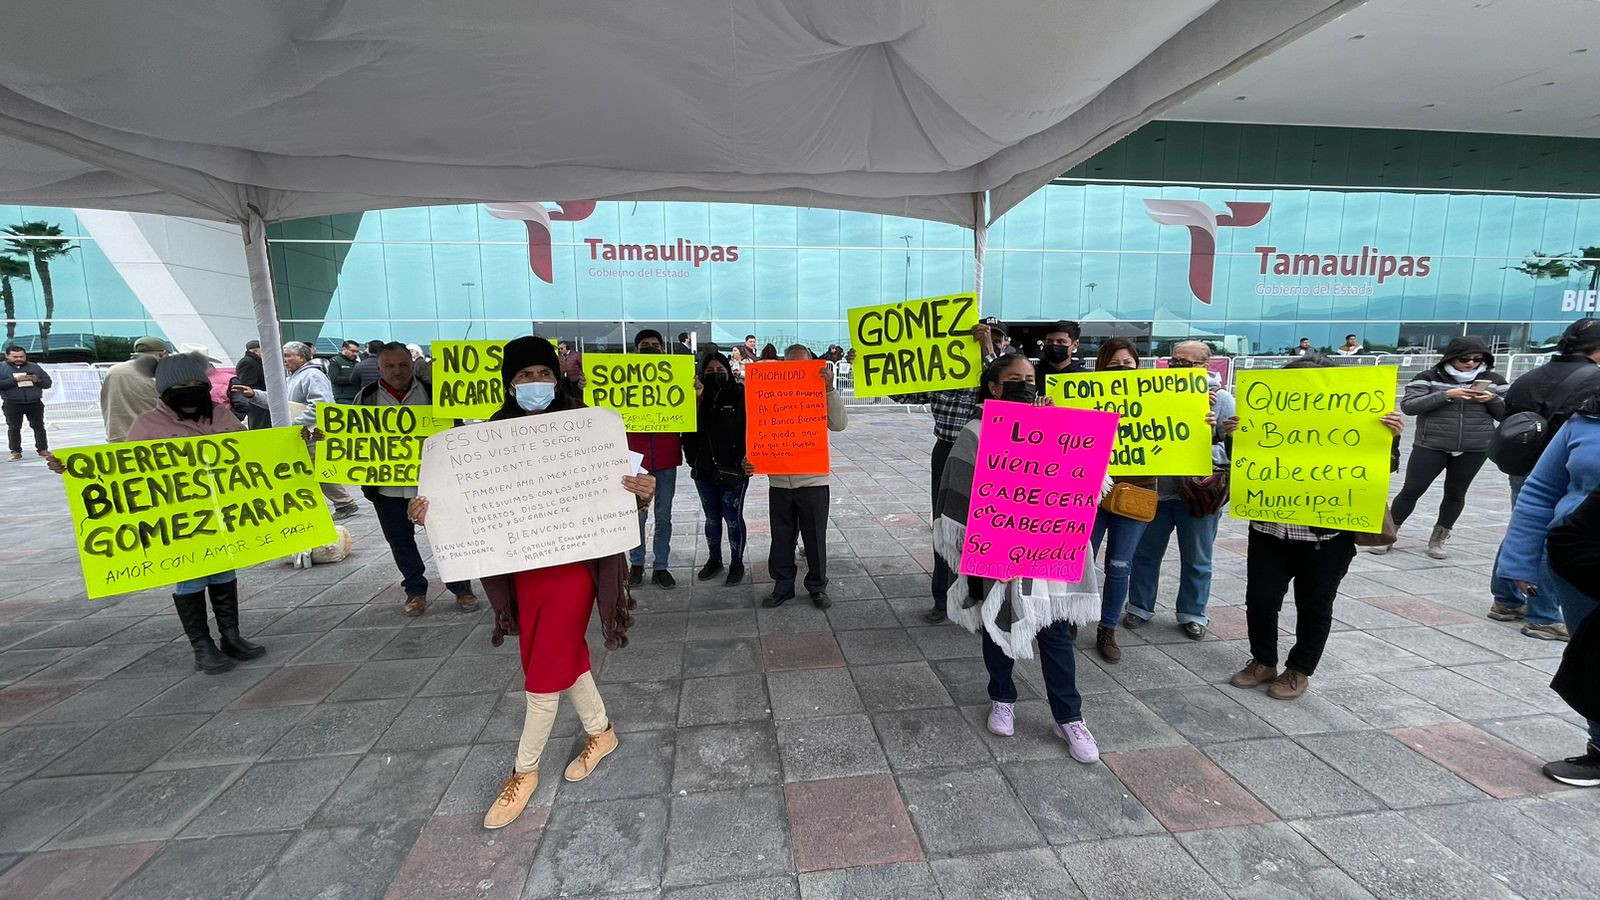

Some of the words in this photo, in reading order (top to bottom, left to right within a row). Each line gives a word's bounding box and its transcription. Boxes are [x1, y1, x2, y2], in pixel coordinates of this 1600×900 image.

[584, 238, 739, 267] Tamaulipas
[1254, 246, 1430, 283] Tamaulipas
[588, 268, 635, 278] Gobierno
[638, 268, 653, 278] del
[656, 269, 690, 278] Estado
[1255, 283, 1310, 297] Gobierno
[1312, 283, 1331, 297] del
[1333, 284, 1373, 297] Estado
[857, 297, 973, 346] GÓMEZ
[442, 344, 480, 374] NO
[484, 344, 503, 372] S
[592, 360, 673, 386] SOMOS
[863, 340, 971, 386] FARIAS
[439, 377, 503, 407] ACARR
[592, 384, 685, 408] PUEBLO
[1111, 377, 1128, 396] el
[1137, 372, 1208, 397] pueblo
[1246, 381, 1386, 415] Queremos
[324, 406, 417, 434] BANCO
[421, 415, 443, 428] DE
[771, 417, 794, 426] Banco
[1093, 398, 1143, 418] todo
[445, 433, 470, 450] ES
[477, 428, 503, 442] UN
[510, 421, 558, 437] HONOR
[563, 418, 593, 432] QUE
[625, 423, 670, 431] RESENTE
[771, 430, 796, 440] queda
[1117, 416, 1190, 446] pueblo
[1240, 418, 1255, 433] el
[1258, 421, 1361, 448] Banco
[326, 435, 429, 461] BIENEST
[450, 451, 482, 468] NOS
[488, 442, 537, 458] VISITE
[542, 434, 581, 447] SEÑOR
[1057, 432, 1096, 454] que
[66, 438, 242, 480] QUEREMOS
[321, 464, 338, 480] EN
[347, 463, 421, 484] CABEC
[456, 459, 533, 485] PRESIDENTE
[560, 442, 615, 460] SERVIDORA
[988, 451, 1060, 477] viene
[1071, 466, 1085, 478] a
[1235, 456, 1248, 468] en
[1246, 456, 1368, 482] Cabecera
[81, 461, 273, 520] BIENESTAR
[273, 460, 313, 480] en
[461, 483, 513, 500] TAMBIEN
[516, 478, 535, 488] AMA
[547, 466, 587, 480] MEXICO
[465, 505, 478, 514] LE
[481, 494, 534, 511] RESIVIMOS
[538, 489, 552, 498] CON
[556, 485, 572, 494] LOS
[575, 475, 609, 488] BRAZOS
[979, 483, 1095, 508] CABECERA
[471, 510, 515, 525] ABIERTOS
[521, 503, 544, 514] DIOS
[560, 490, 599, 504] BENDIGA
[1246, 488, 1352, 512] Municipal
[84, 508, 217, 557] GOMEZ
[221, 488, 318, 533] FARIAS
[472, 522, 503, 535] USTED
[528, 506, 570, 521] GABINETE
[507, 521, 575, 545] BIENVENIDO
[582, 516, 594, 525] EN
[597, 512, 617, 521] HORA
[973, 504, 997, 519] en
[991, 513, 1086, 534] CABECERA
[105, 559, 153, 584] AMOR
[160, 552, 194, 570] CON
[203, 539, 249, 560] AMOR
[257, 534, 273, 548] SE
[280, 524, 315, 539] PAGA
[435, 540, 485, 553] BIENVENIDO
[450, 546, 495, 560] PRESIDENTE
[521, 540, 556, 554] CATALINA
[968, 534, 992, 555] Se
